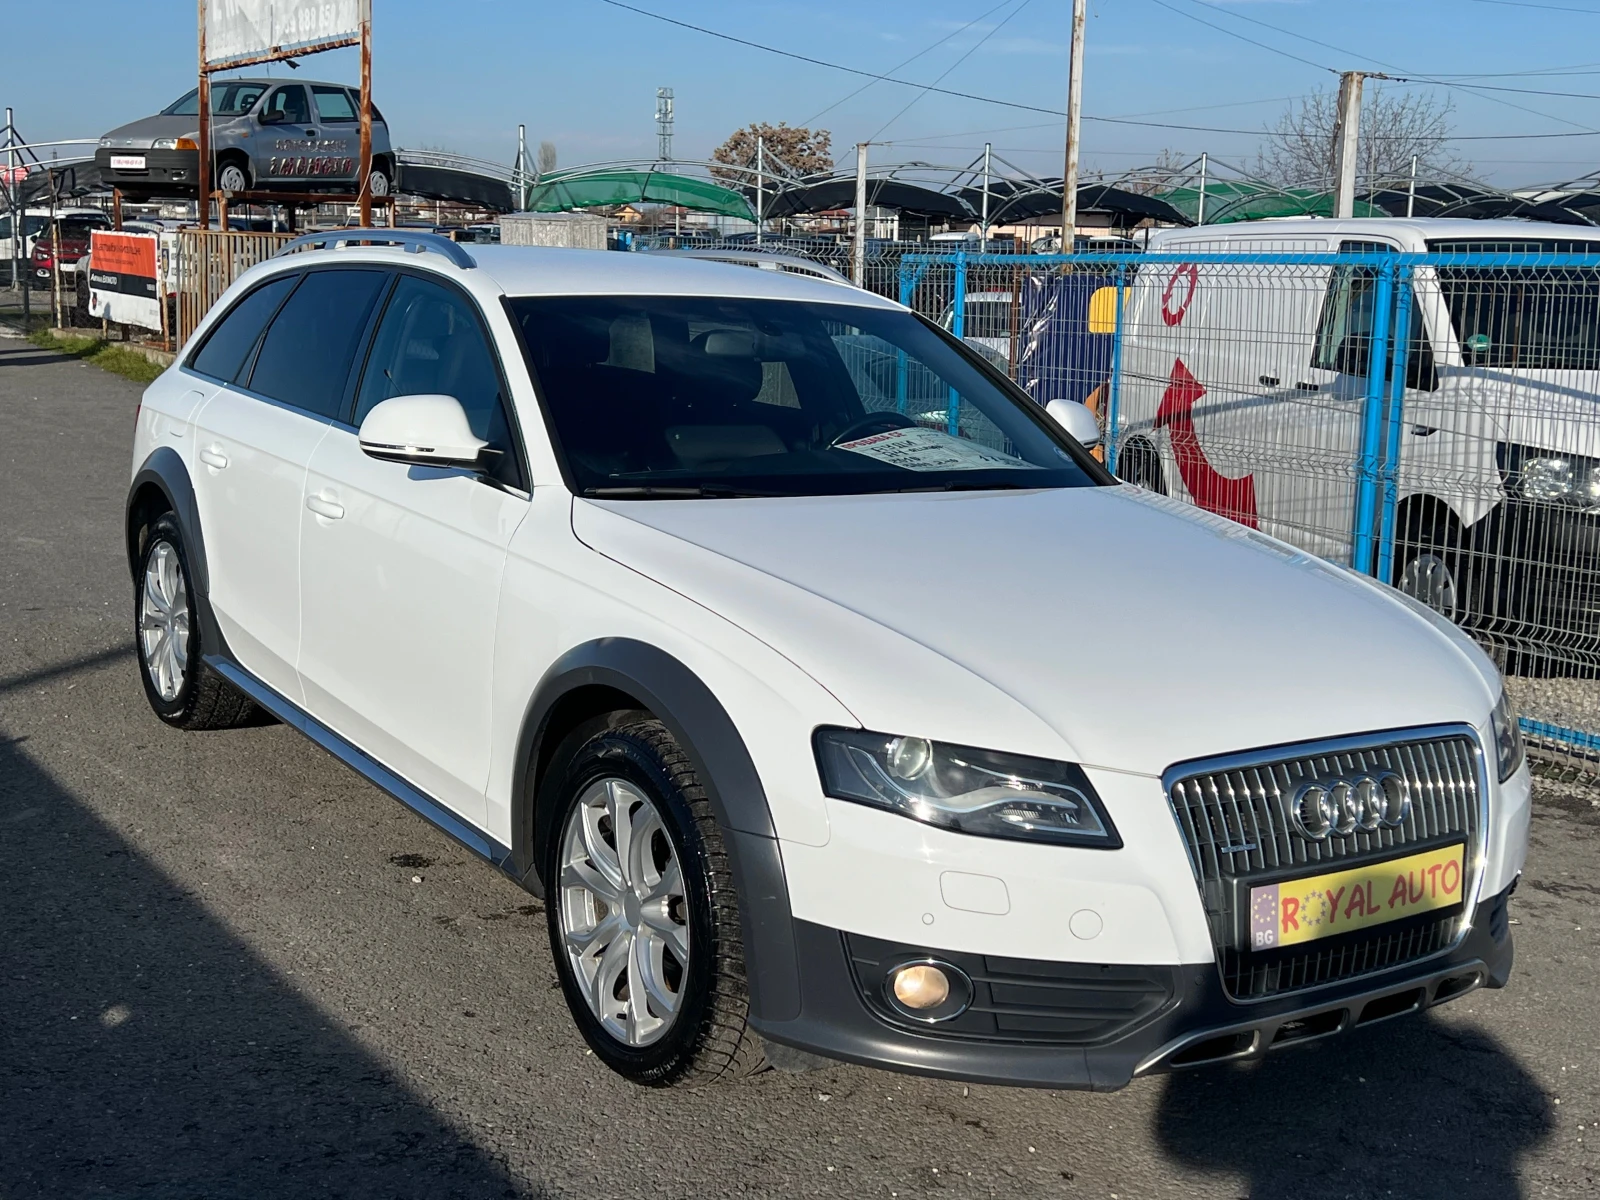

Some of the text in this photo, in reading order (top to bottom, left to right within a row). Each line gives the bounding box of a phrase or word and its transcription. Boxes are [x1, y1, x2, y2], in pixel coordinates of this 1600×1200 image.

[1281, 859, 1461, 934] ROYAL AUTO
[1255, 929, 1274, 947] BG
